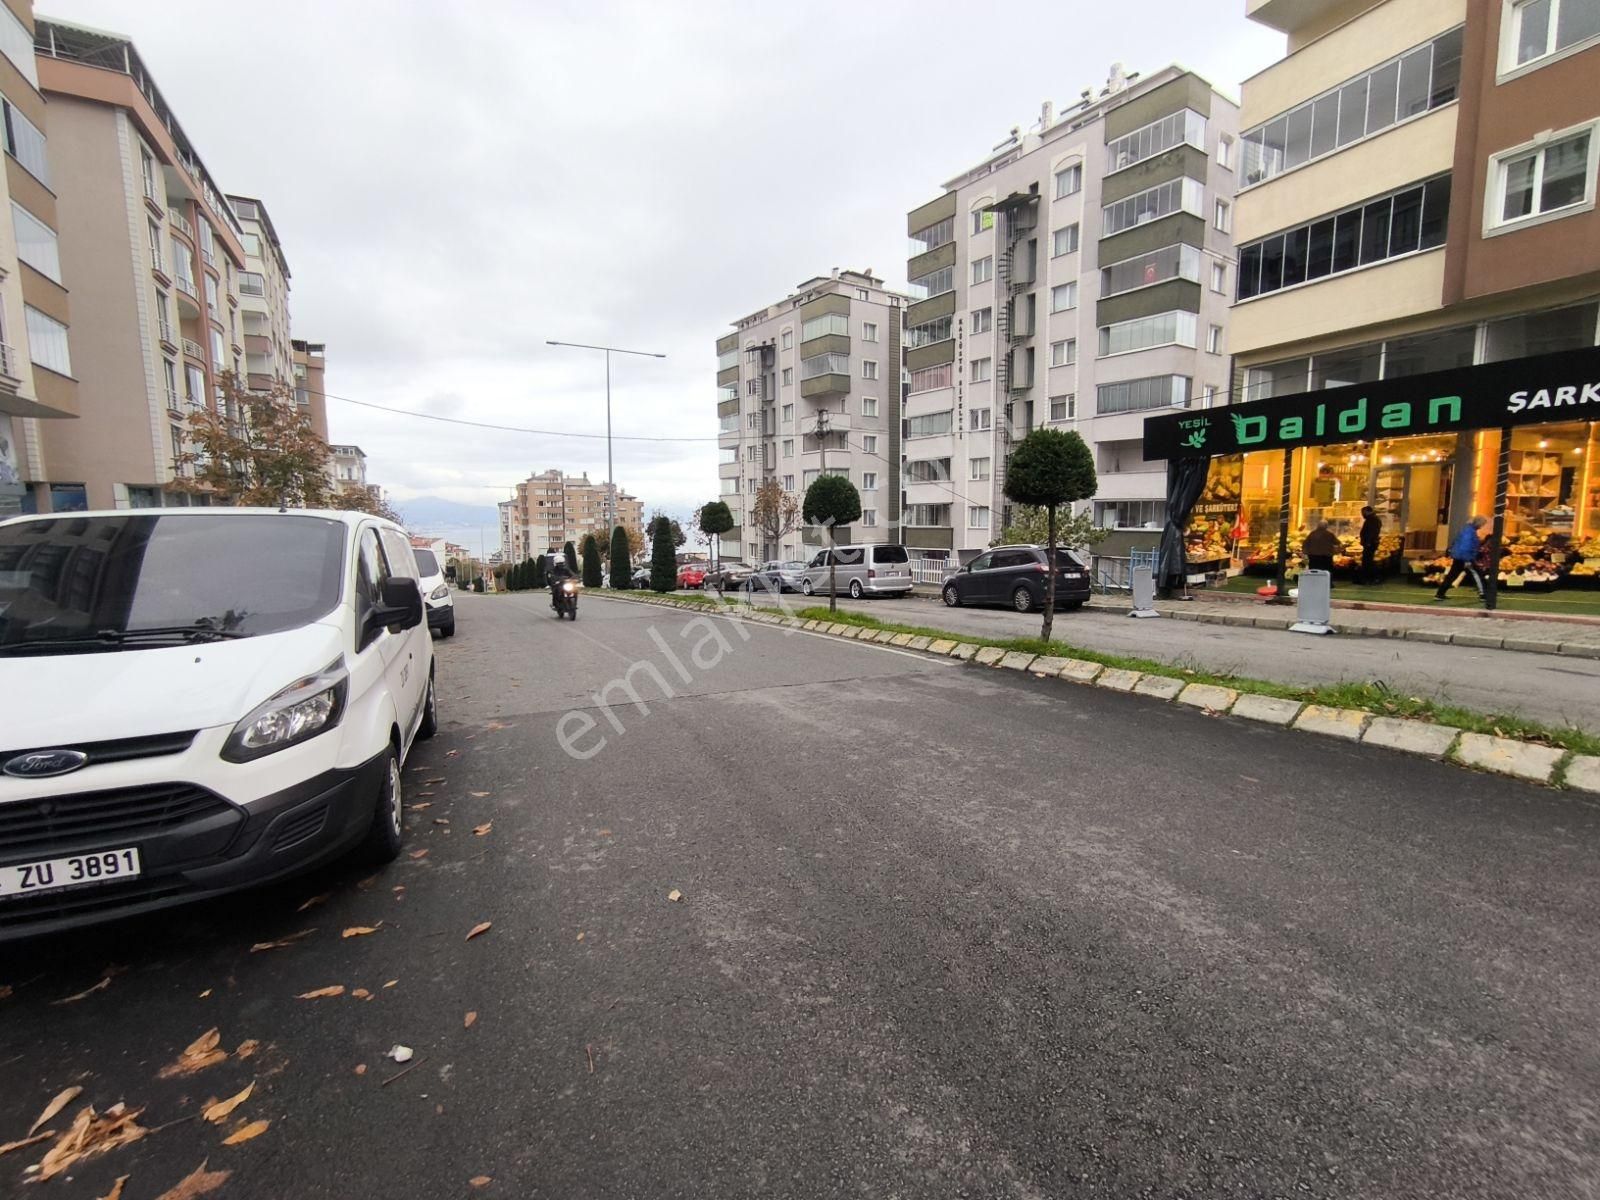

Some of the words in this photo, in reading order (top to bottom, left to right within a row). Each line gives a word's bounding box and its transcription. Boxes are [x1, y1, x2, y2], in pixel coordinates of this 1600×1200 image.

[1231, 395, 1462, 445] Daldan
[21, 754, 65, 771] Ford
[17, 862, 54, 889] ZU
[68, 850, 134, 881] 3891
